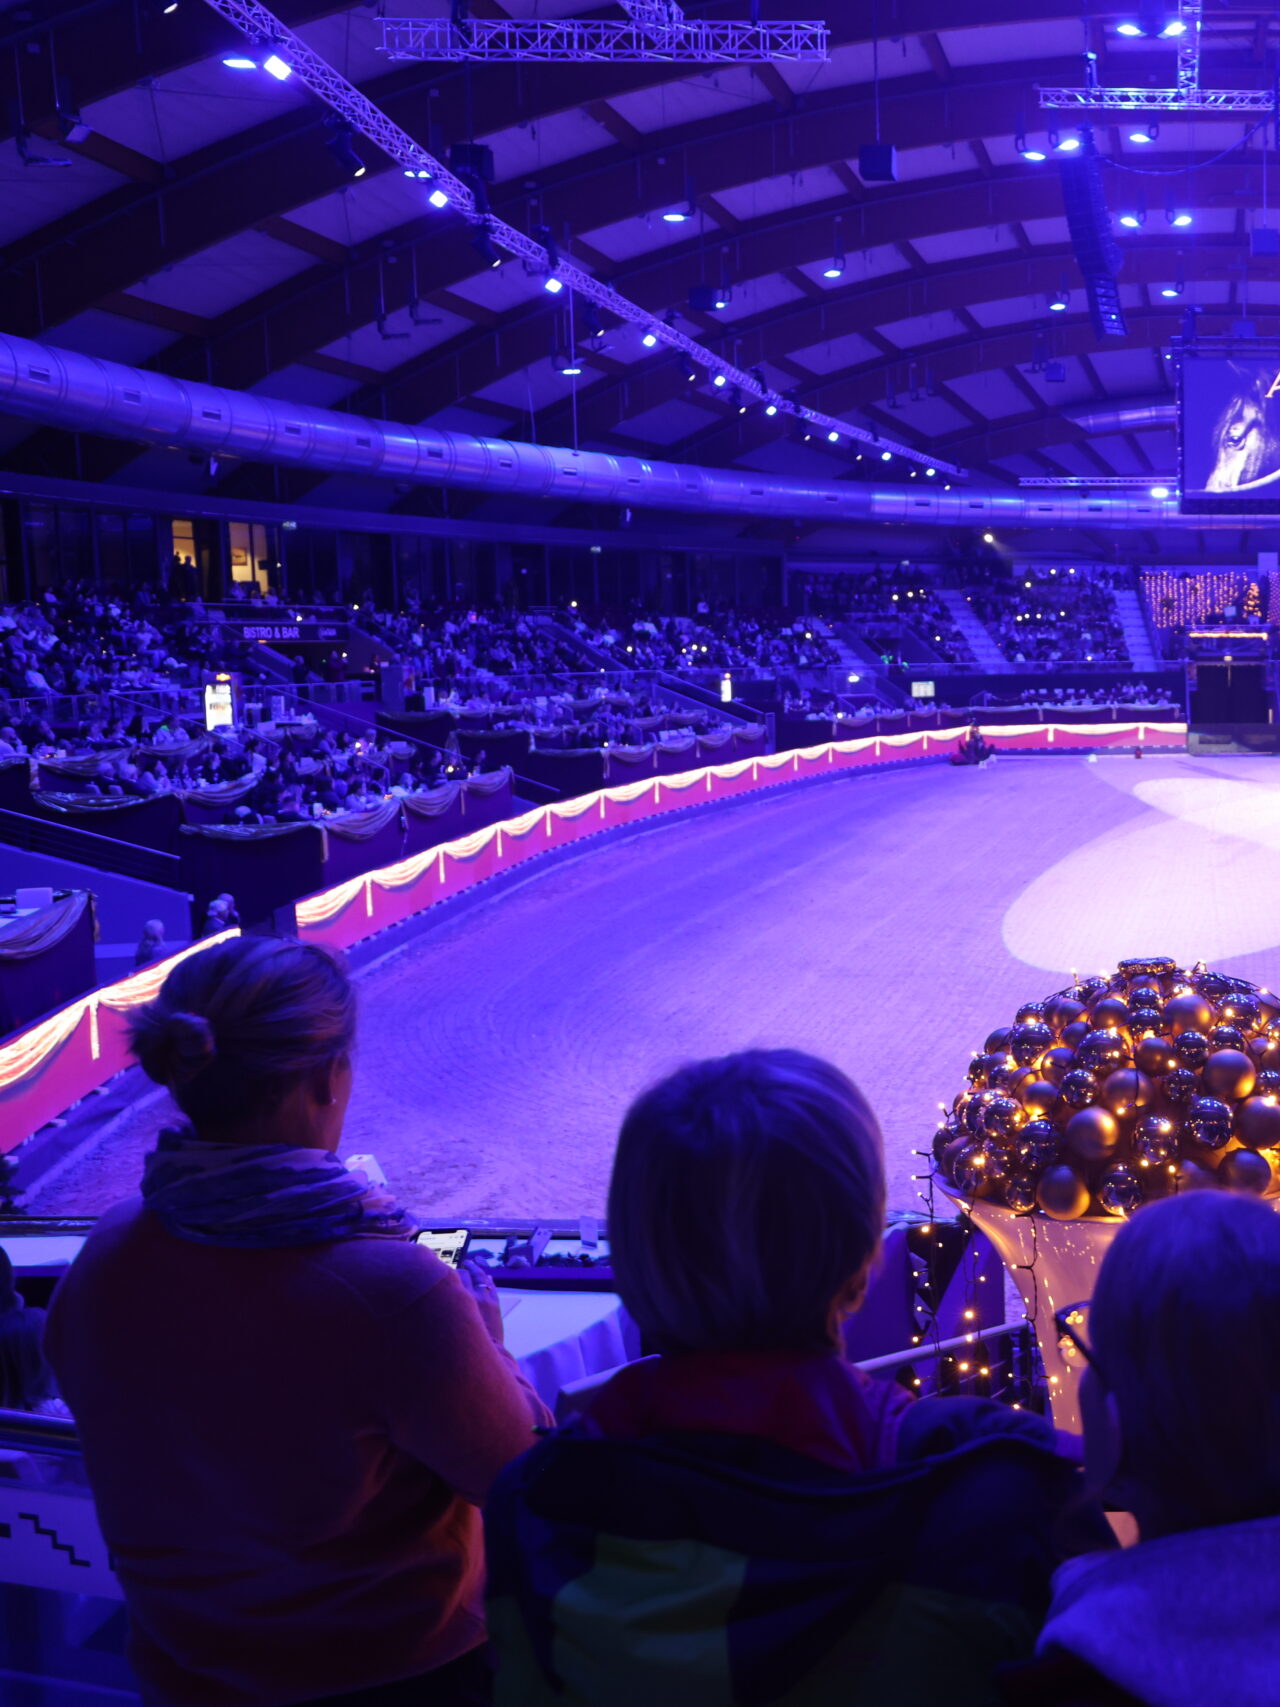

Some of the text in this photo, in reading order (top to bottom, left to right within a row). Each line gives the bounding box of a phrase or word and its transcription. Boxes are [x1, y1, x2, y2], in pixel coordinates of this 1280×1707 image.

[243, 626, 301, 639] BISTRO & BAR
